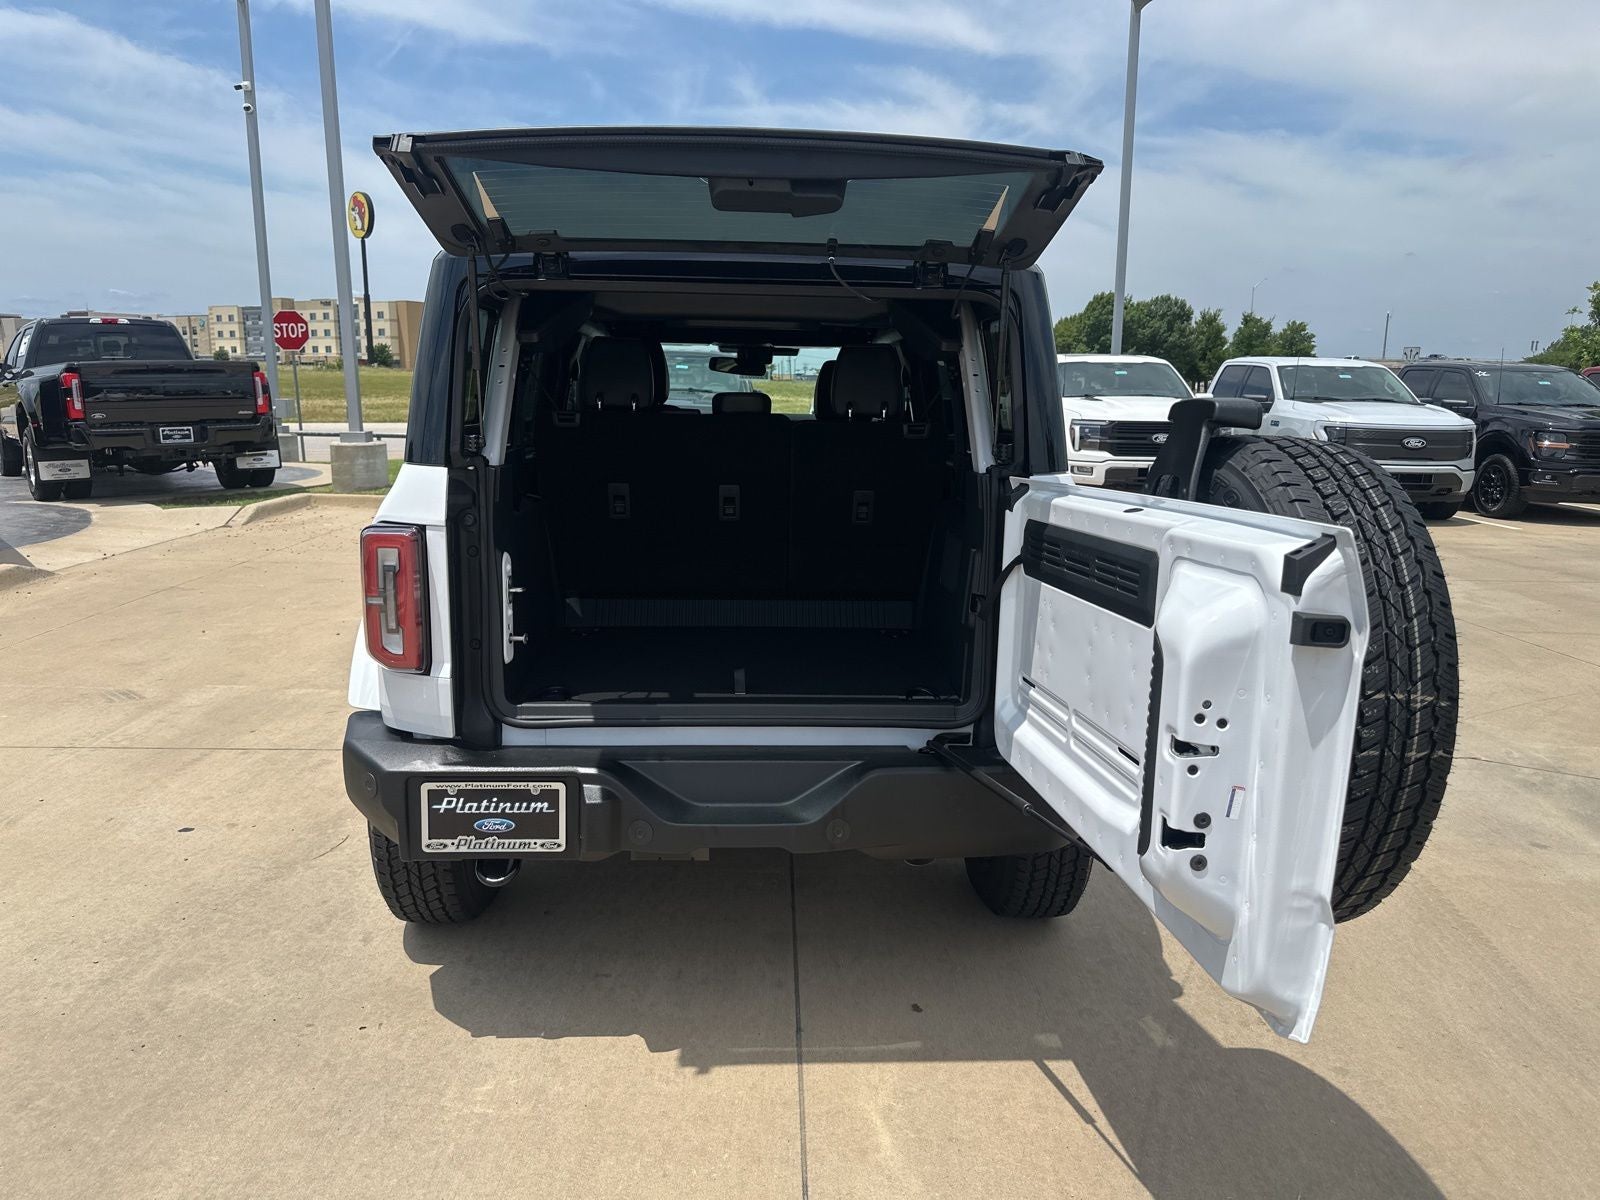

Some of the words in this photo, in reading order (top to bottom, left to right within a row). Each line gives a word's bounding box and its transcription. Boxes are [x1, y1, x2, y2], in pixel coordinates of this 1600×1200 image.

[273, 323, 307, 338] STOP
[432, 797, 555, 813] Platinum
[482, 820, 507, 831] Ford
[456, 837, 537, 850] Platinum
